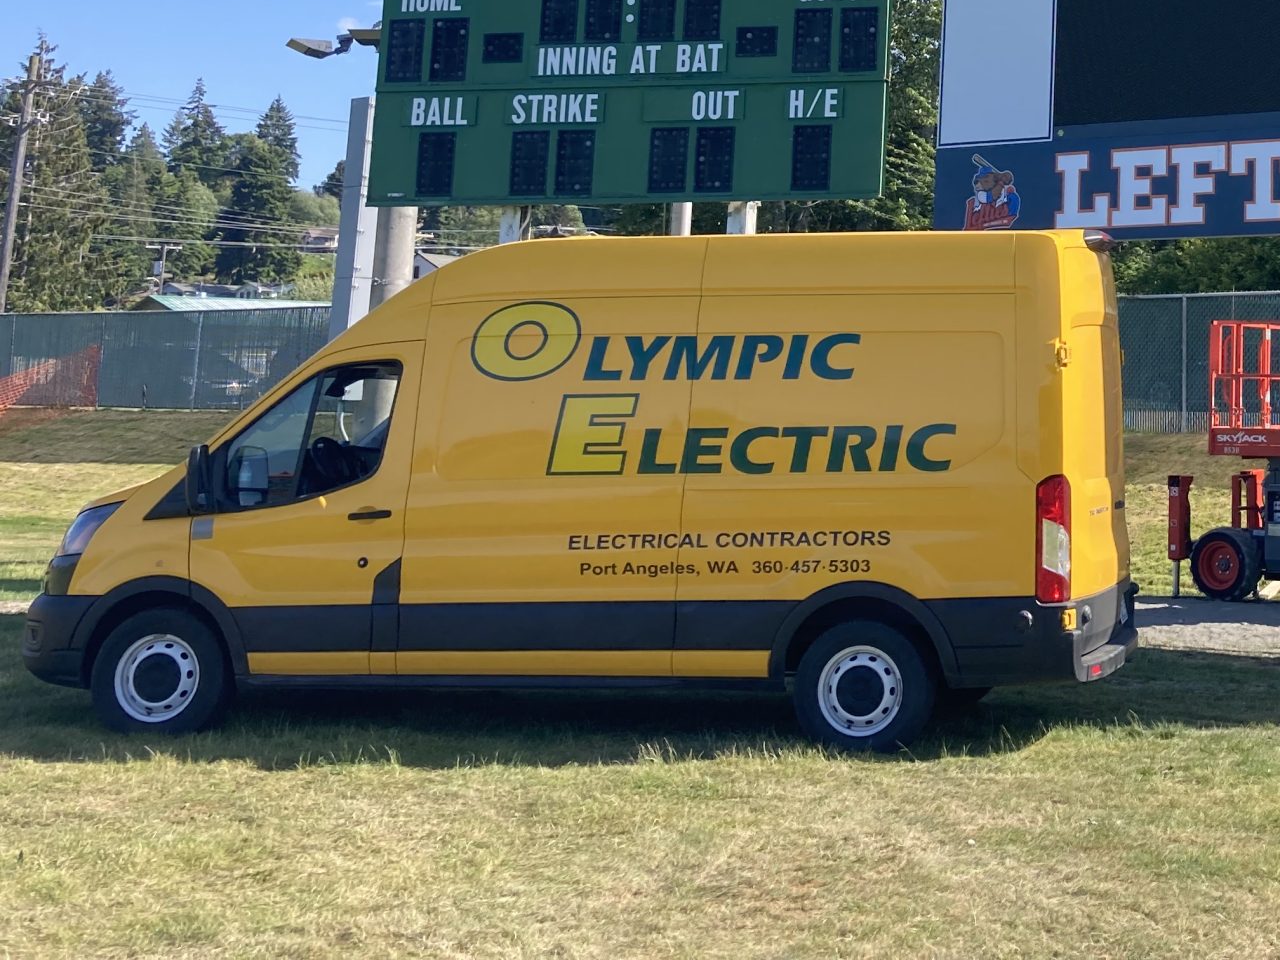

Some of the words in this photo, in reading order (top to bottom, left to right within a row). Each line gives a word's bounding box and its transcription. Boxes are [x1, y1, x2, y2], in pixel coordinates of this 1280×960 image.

[537, 45, 617, 76] INNING
[630, 44, 661, 74] AT
[676, 43, 723, 73] BAT
[410, 96, 468, 126] BALL
[511, 93, 599, 124] STRIKE
[691, 90, 739, 120] OUT
[788, 88, 838, 119] H/E
[470, 300, 861, 382] OLYMPIC
[545, 392, 957, 476] ELECTRIC
[1216, 431, 1267, 443] SKYJACK
[568, 533, 708, 550] ELECTRICAL
[715, 530, 891, 548] CONTRACTORS
[580, 562, 617, 576] Port
[621, 561, 700, 578] Angeles,
[707, 560, 739, 575] WA
